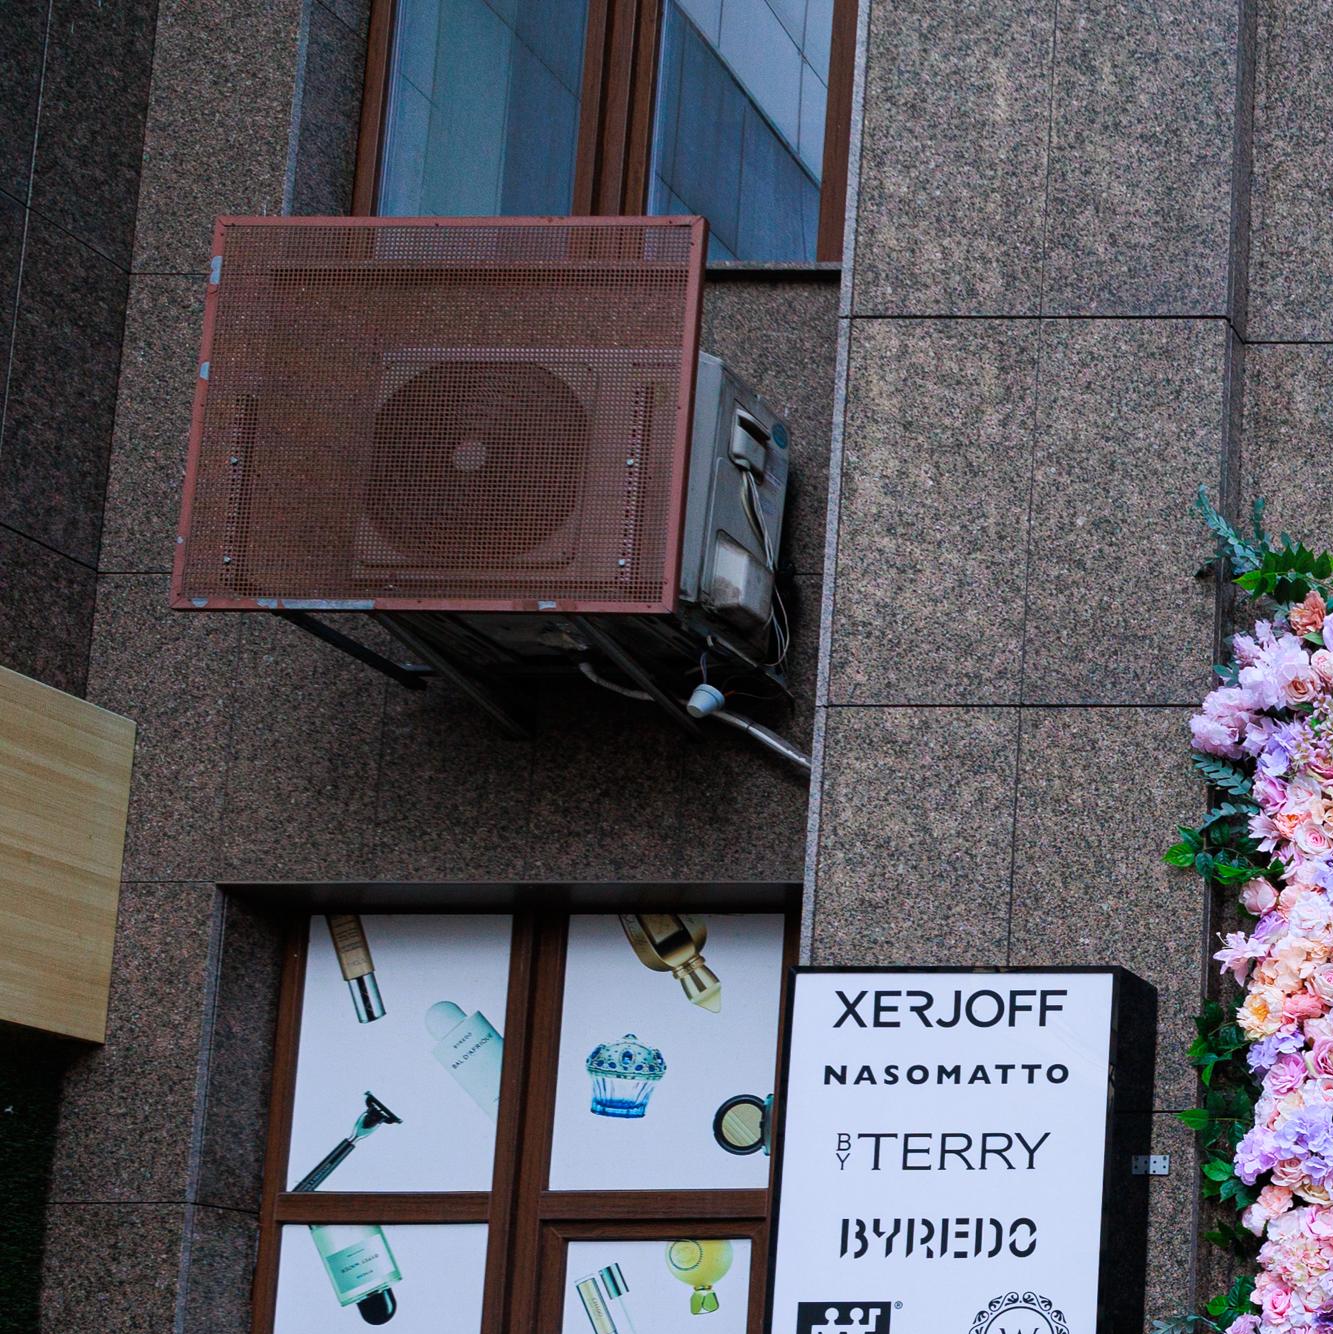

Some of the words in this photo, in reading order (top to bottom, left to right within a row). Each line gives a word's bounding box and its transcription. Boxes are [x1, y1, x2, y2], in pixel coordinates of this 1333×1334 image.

[832, 989, 1068, 1029] XERJOFF
[823, 1063, 1070, 1086] NASOMATTO
[857, 1131, 1052, 1171] TERRY
[839, 1217, 1038, 1260] BYREDO
